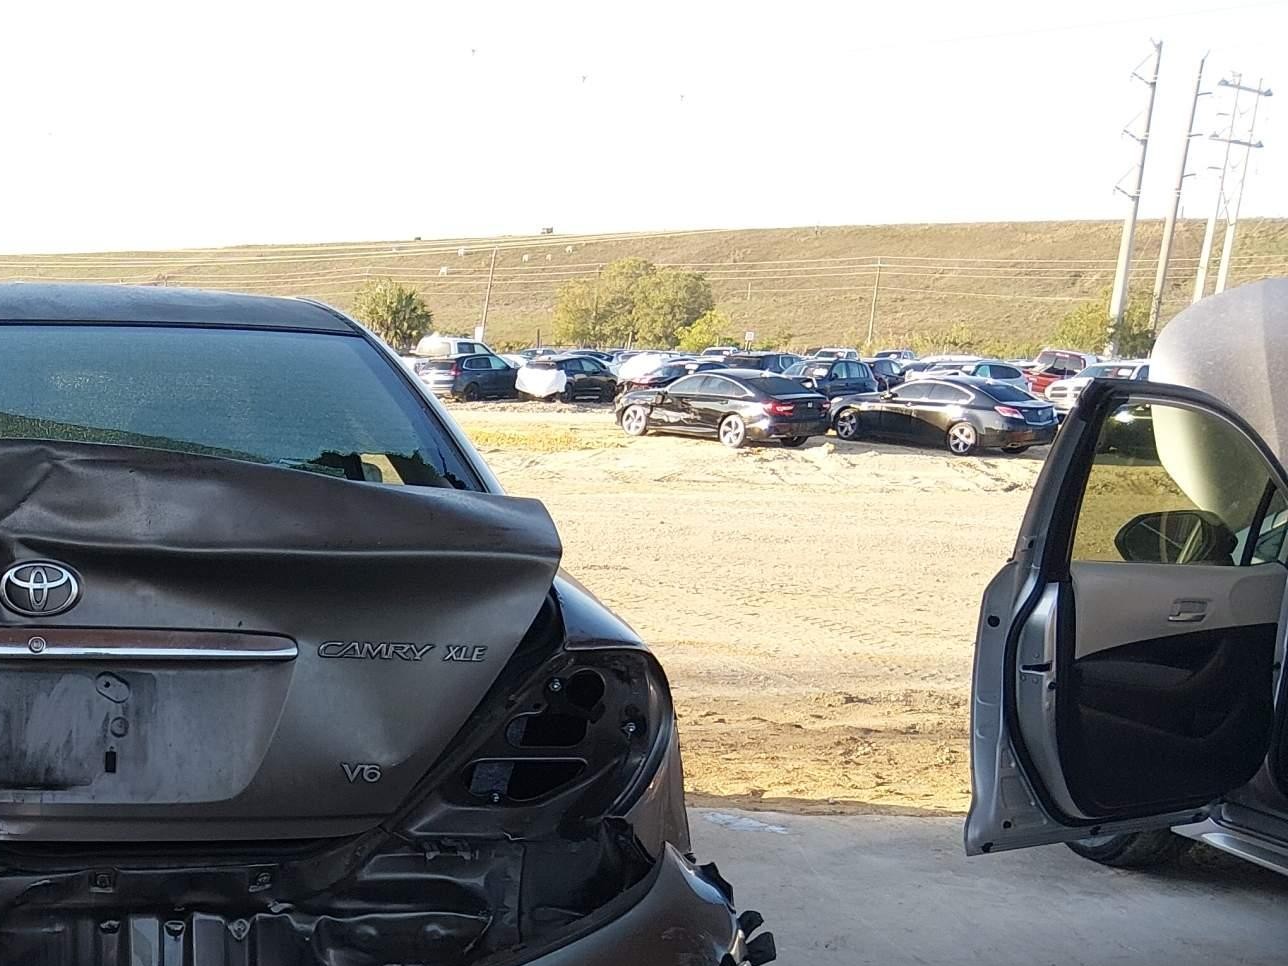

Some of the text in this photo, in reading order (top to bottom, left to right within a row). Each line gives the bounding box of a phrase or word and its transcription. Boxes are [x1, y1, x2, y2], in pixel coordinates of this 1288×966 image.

[318, 641, 487, 662] CAMRY XLE
[341, 763, 382, 783] V6
